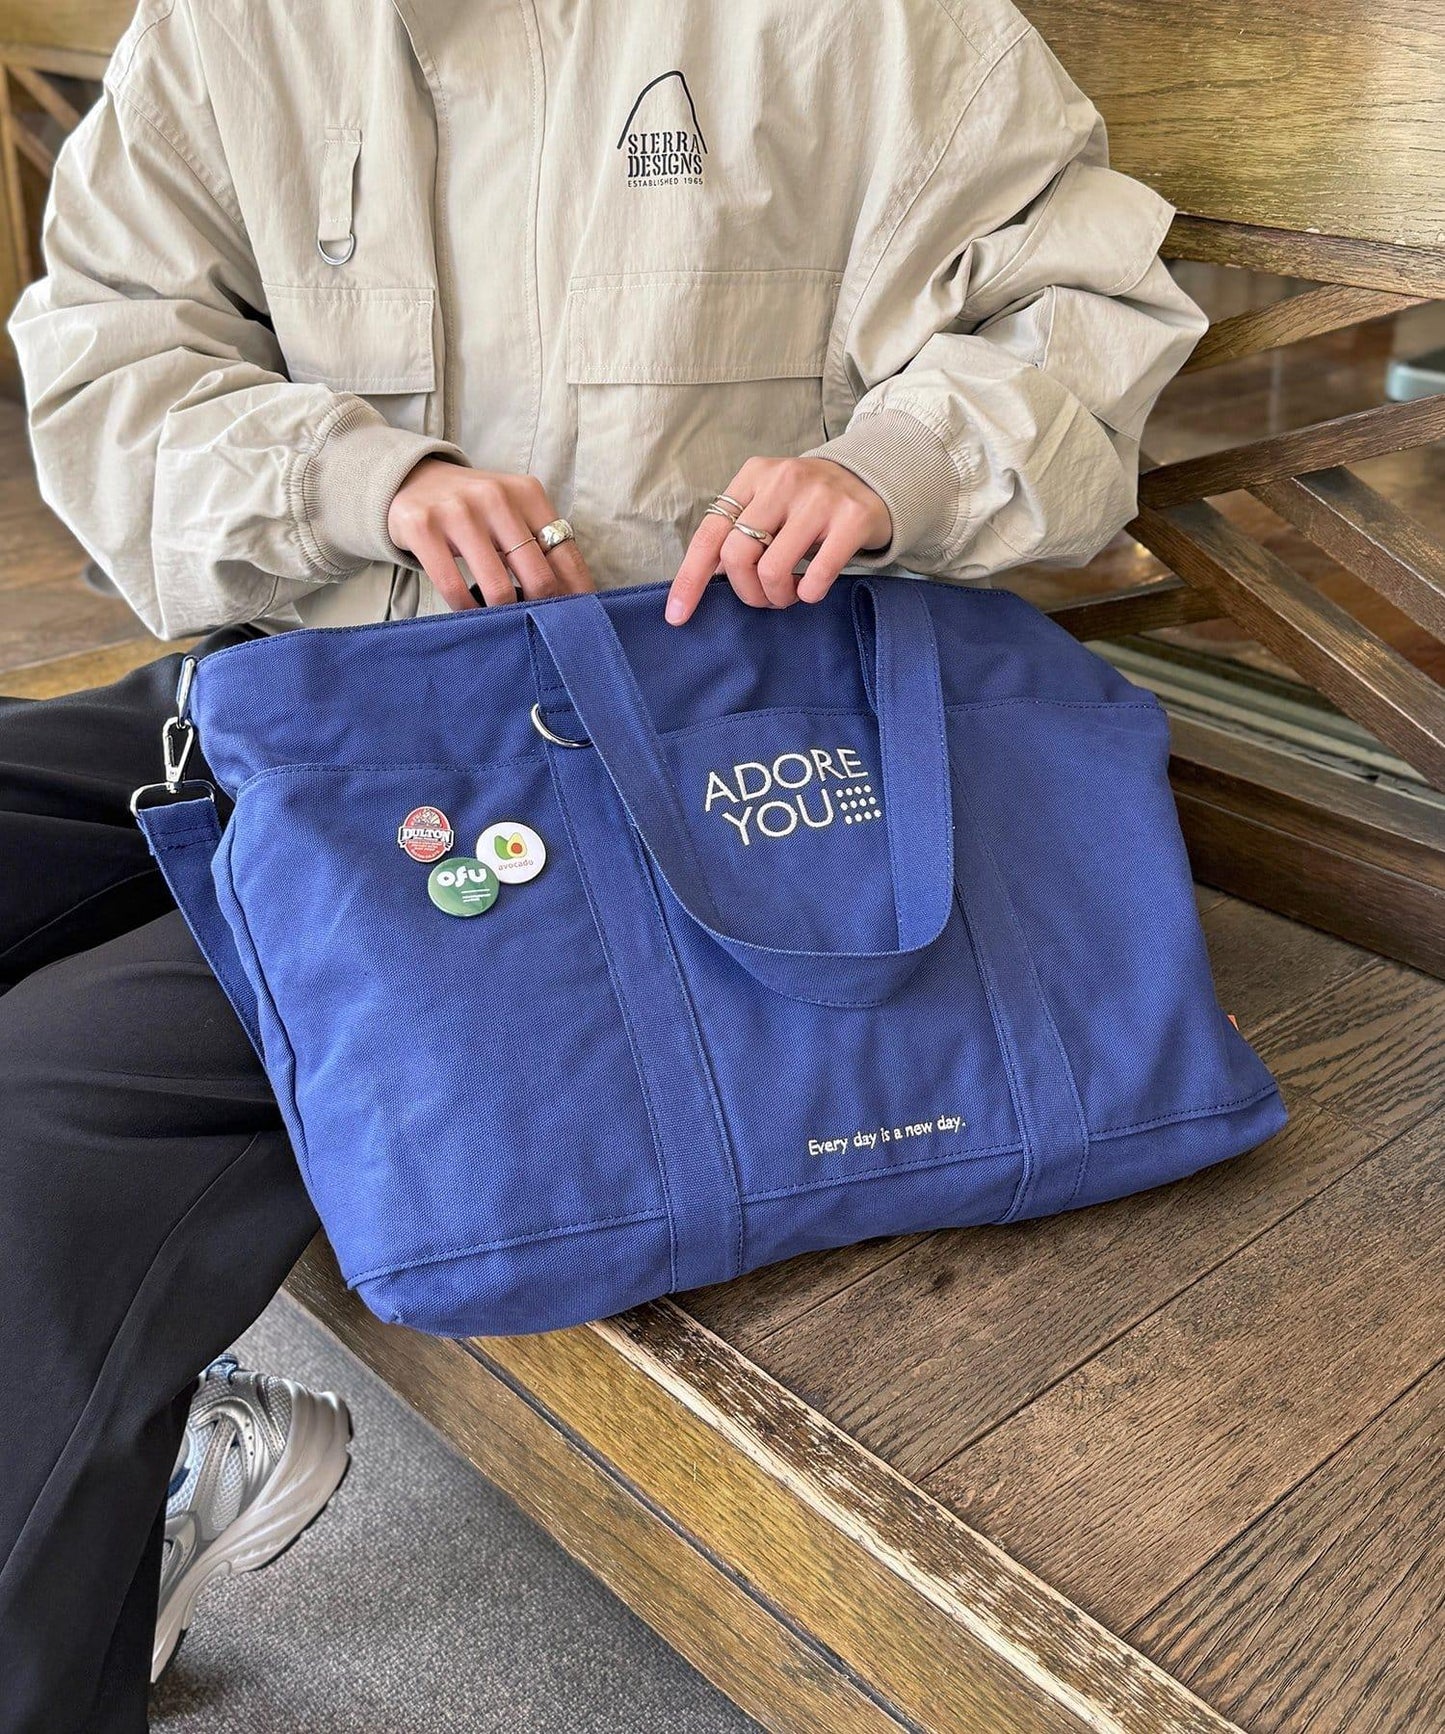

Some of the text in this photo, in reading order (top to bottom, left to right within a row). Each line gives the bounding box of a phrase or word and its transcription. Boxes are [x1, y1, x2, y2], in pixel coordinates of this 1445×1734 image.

[628, 131, 701, 154] SIERRA
[627, 153, 703, 178] DESIGNS
[627, 177, 704, 188] ESTABLISHED 1965
[705, 748, 869, 812] ADORE
[722, 788, 834, 846] YOU
[401, 828, 451, 844] DULTON
[436, 865, 488, 888] ofu
[498, 858, 535, 872] avocado
[808, 1114, 967, 1156] Every day is a new day.
